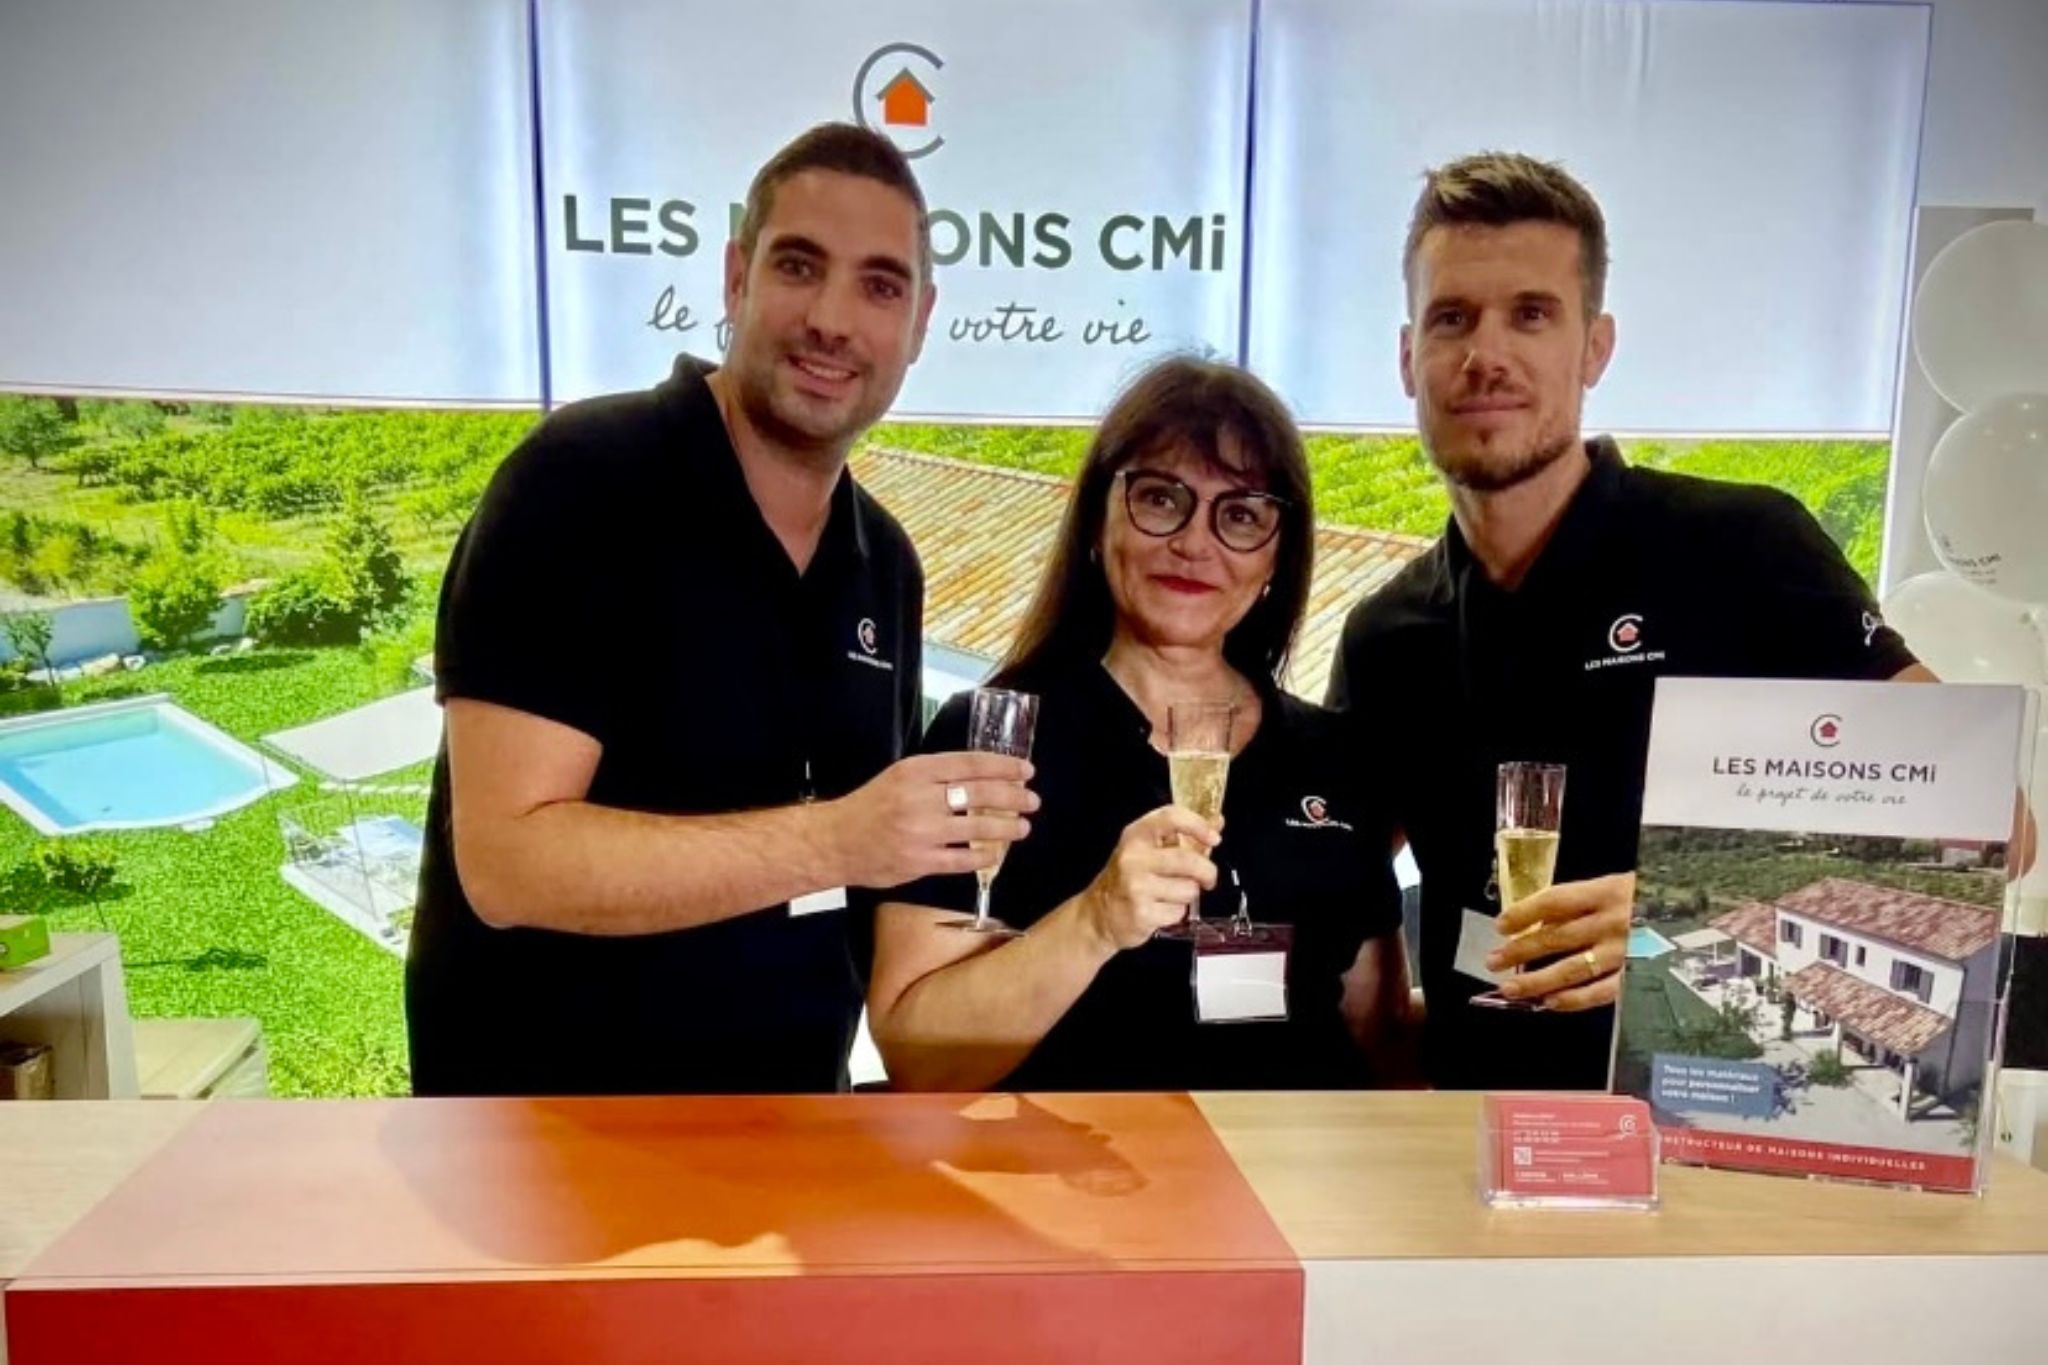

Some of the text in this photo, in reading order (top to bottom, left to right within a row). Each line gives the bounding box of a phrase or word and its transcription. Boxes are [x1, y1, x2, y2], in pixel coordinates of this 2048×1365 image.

[563, 194, 699, 258] LES
[1099, 213, 1226, 271] CMi
[647, 284, 1151, 343] le votre vie
[1602, 652, 1646, 667] MAISONS
[1712, 756, 1938, 784] LES MAISONS CMi
[1735, 783, 1909, 807] le projet de votre vie
[1747, 1143, 1762, 1153] DE
[1768, 1145, 1824, 1161] MAISONS
[1828, 1152, 1926, 1171] INDIVIDUELLES
